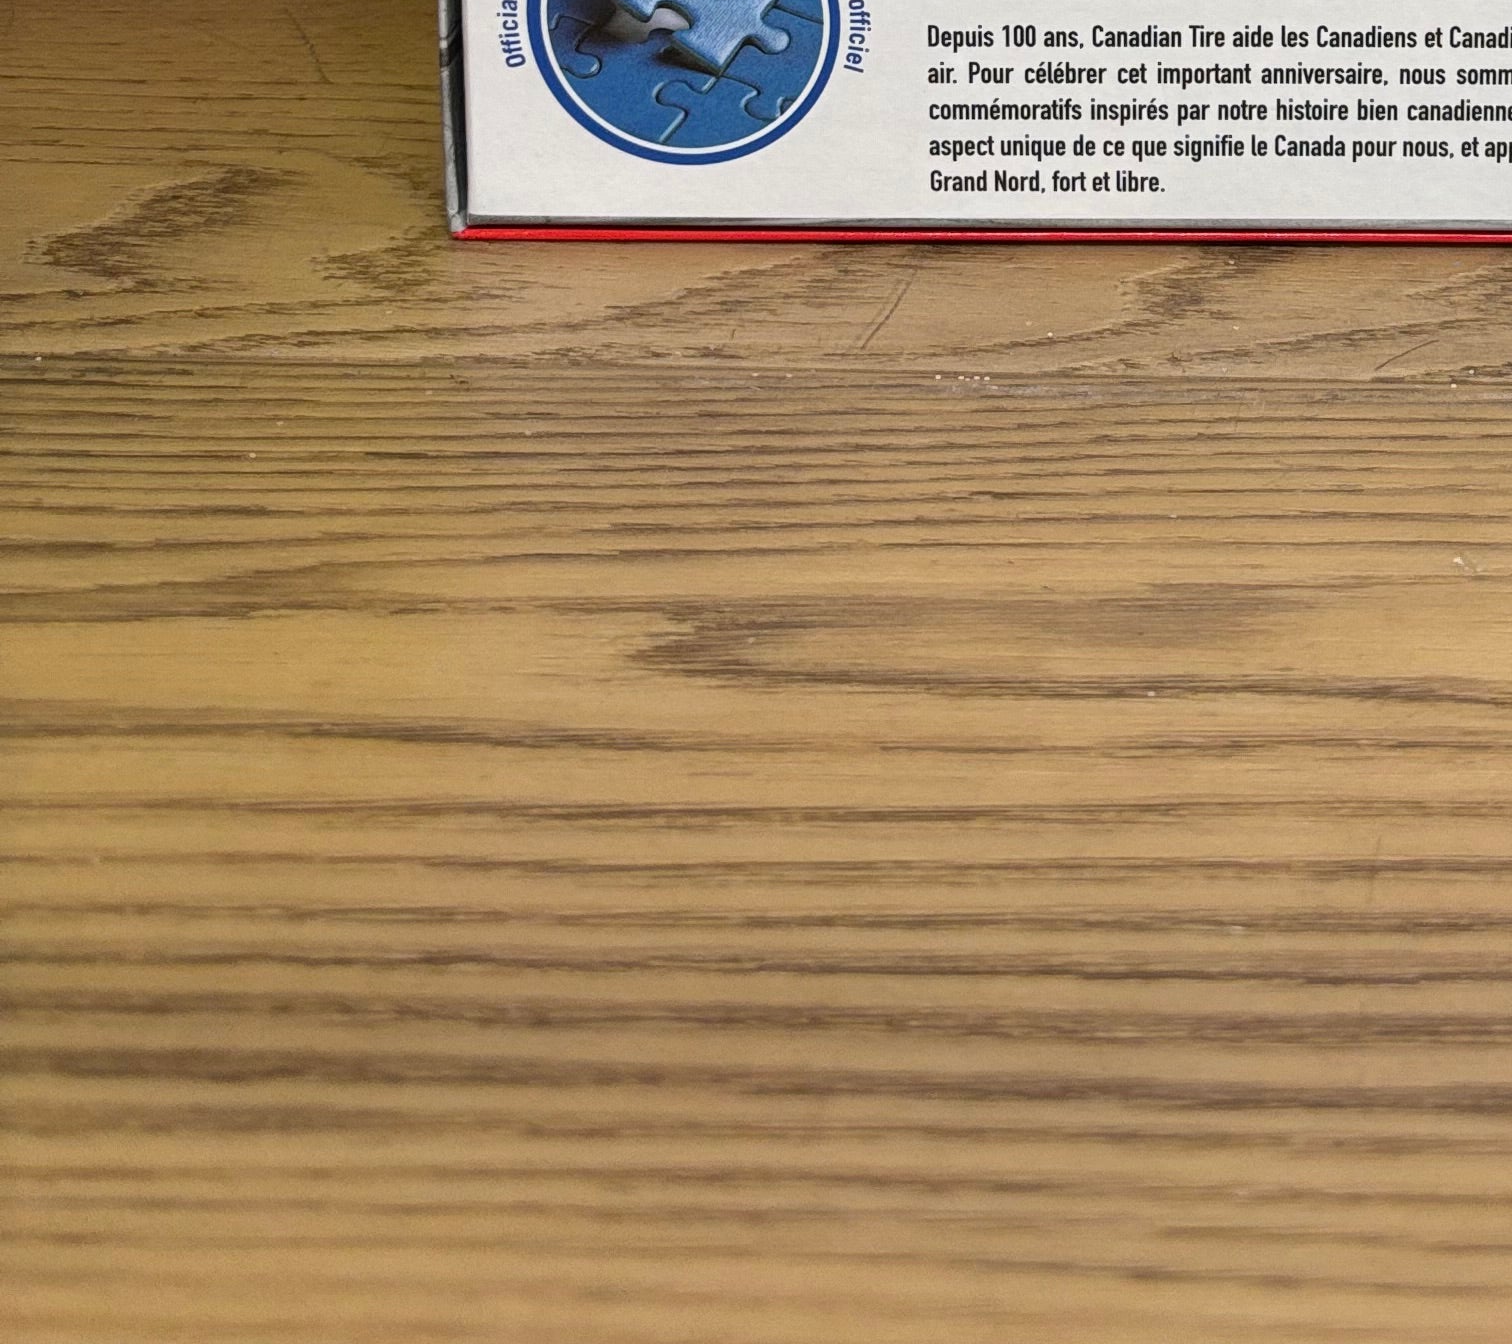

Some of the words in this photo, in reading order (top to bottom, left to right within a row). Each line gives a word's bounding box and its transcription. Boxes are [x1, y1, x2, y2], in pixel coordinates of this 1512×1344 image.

[928, 25, 993, 53] Depuis
[1002, 25, 1036, 47] 100
[1044, 31, 1083, 49] ans,
[1093, 25, 1181, 47] Canadian
[1189, 25, 1225, 47] Tire
[1233, 25, 1273, 47] aide
[1282, 25, 1309, 47] les
[1317, 26, 1417, 48] Canadiens
[1425, 28, 1443, 48] et
[931, 170, 987, 191] Grand
[995, 170, 1045, 193] Nord,
[1052, 170, 1086, 192] fort
[1093, 172, 1110, 192] et
[1117, 171, 1165, 192] libre.
